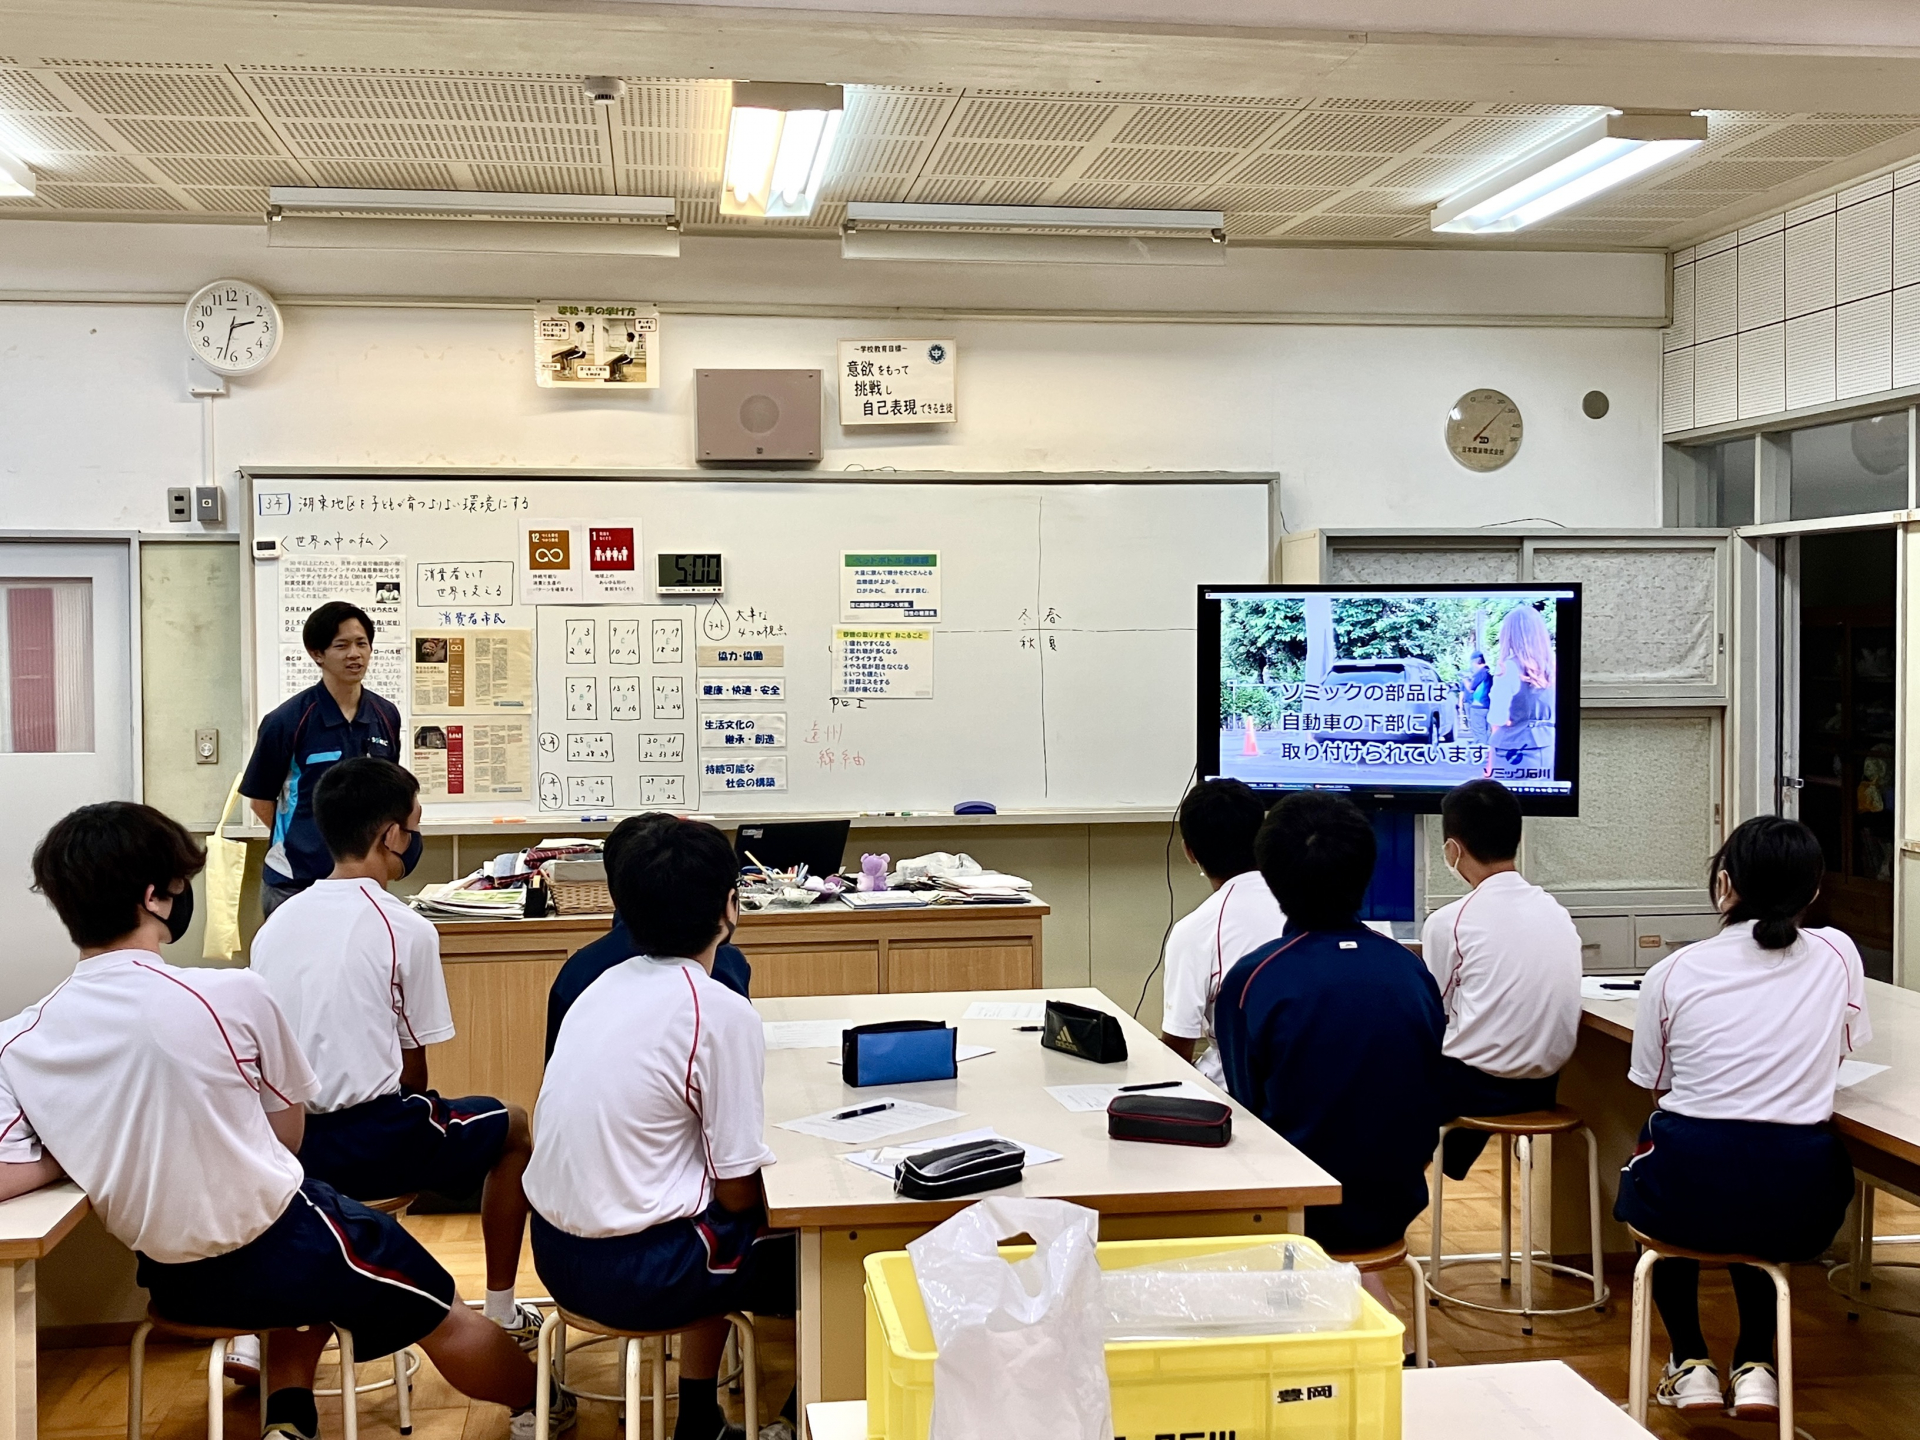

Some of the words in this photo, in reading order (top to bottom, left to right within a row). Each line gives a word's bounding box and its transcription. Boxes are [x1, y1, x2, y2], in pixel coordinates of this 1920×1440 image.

[212, 294, 222, 306] 11
[226, 290, 238, 302] 12
[245, 294, 250, 306] 1
[201, 305, 213, 317] 10
[256, 305, 264, 317] 2
[196, 320, 204, 332] 9
[262, 321, 270, 333] 3
[202, 336, 210, 348] 8
[255, 336, 263, 348] 4
[216, 347, 223, 359] 7
[230, 350, 238, 362] 6
[246, 347, 253, 359] 5
[846, 360, 909, 378] 意欲をもって
[854, 380, 893, 397] 挑戦し
[863, 399, 953, 416] 自己表現できる生徒
[531, 533, 540, 543] 12
[592, 531, 597, 541] 1
[675, 555, 720, 583] 5:00
[436, 585, 502, 601] 世界を支える
[439, 611, 506, 626] 消費者市民
[1018, 609, 1031, 625] 冬
[1043, 608, 1062, 624] 春
[584, 628, 590, 637] 3
[613, 627, 618, 637] 9
[671, 628, 680, 638] 19
[1020, 637, 1035, 650] 秋
[570, 647, 576, 655] 2
[718, 651, 764, 661] 協力・協働
[570, 684, 576, 693] 5
[585, 684, 592, 693] 7
[626, 684, 636, 692] 15
[656, 685, 665, 694] 21
[703, 685, 780, 696] 健康・快適・安全
[1282, 683, 1448, 703] ソミックの部品は
[571, 704, 576, 712] 6
[587, 703, 593, 711] 8
[704, 720, 755, 730] 生活文化の
[1282, 713, 1427, 732] 自動車の下部に
[725, 735, 775, 745] 継承・創造
[572, 750, 581, 758] 27
[600, 749, 609, 759] 29
[1281, 742, 1489, 763] 取り付けられています
[705, 764, 755, 774] 持続可能な
[1483, 767, 1551, 780] ソミック石川
[575, 779, 585, 787] 25
[725, 778, 776, 788] 社会の構築
[595, 795, 606, 803] 28
